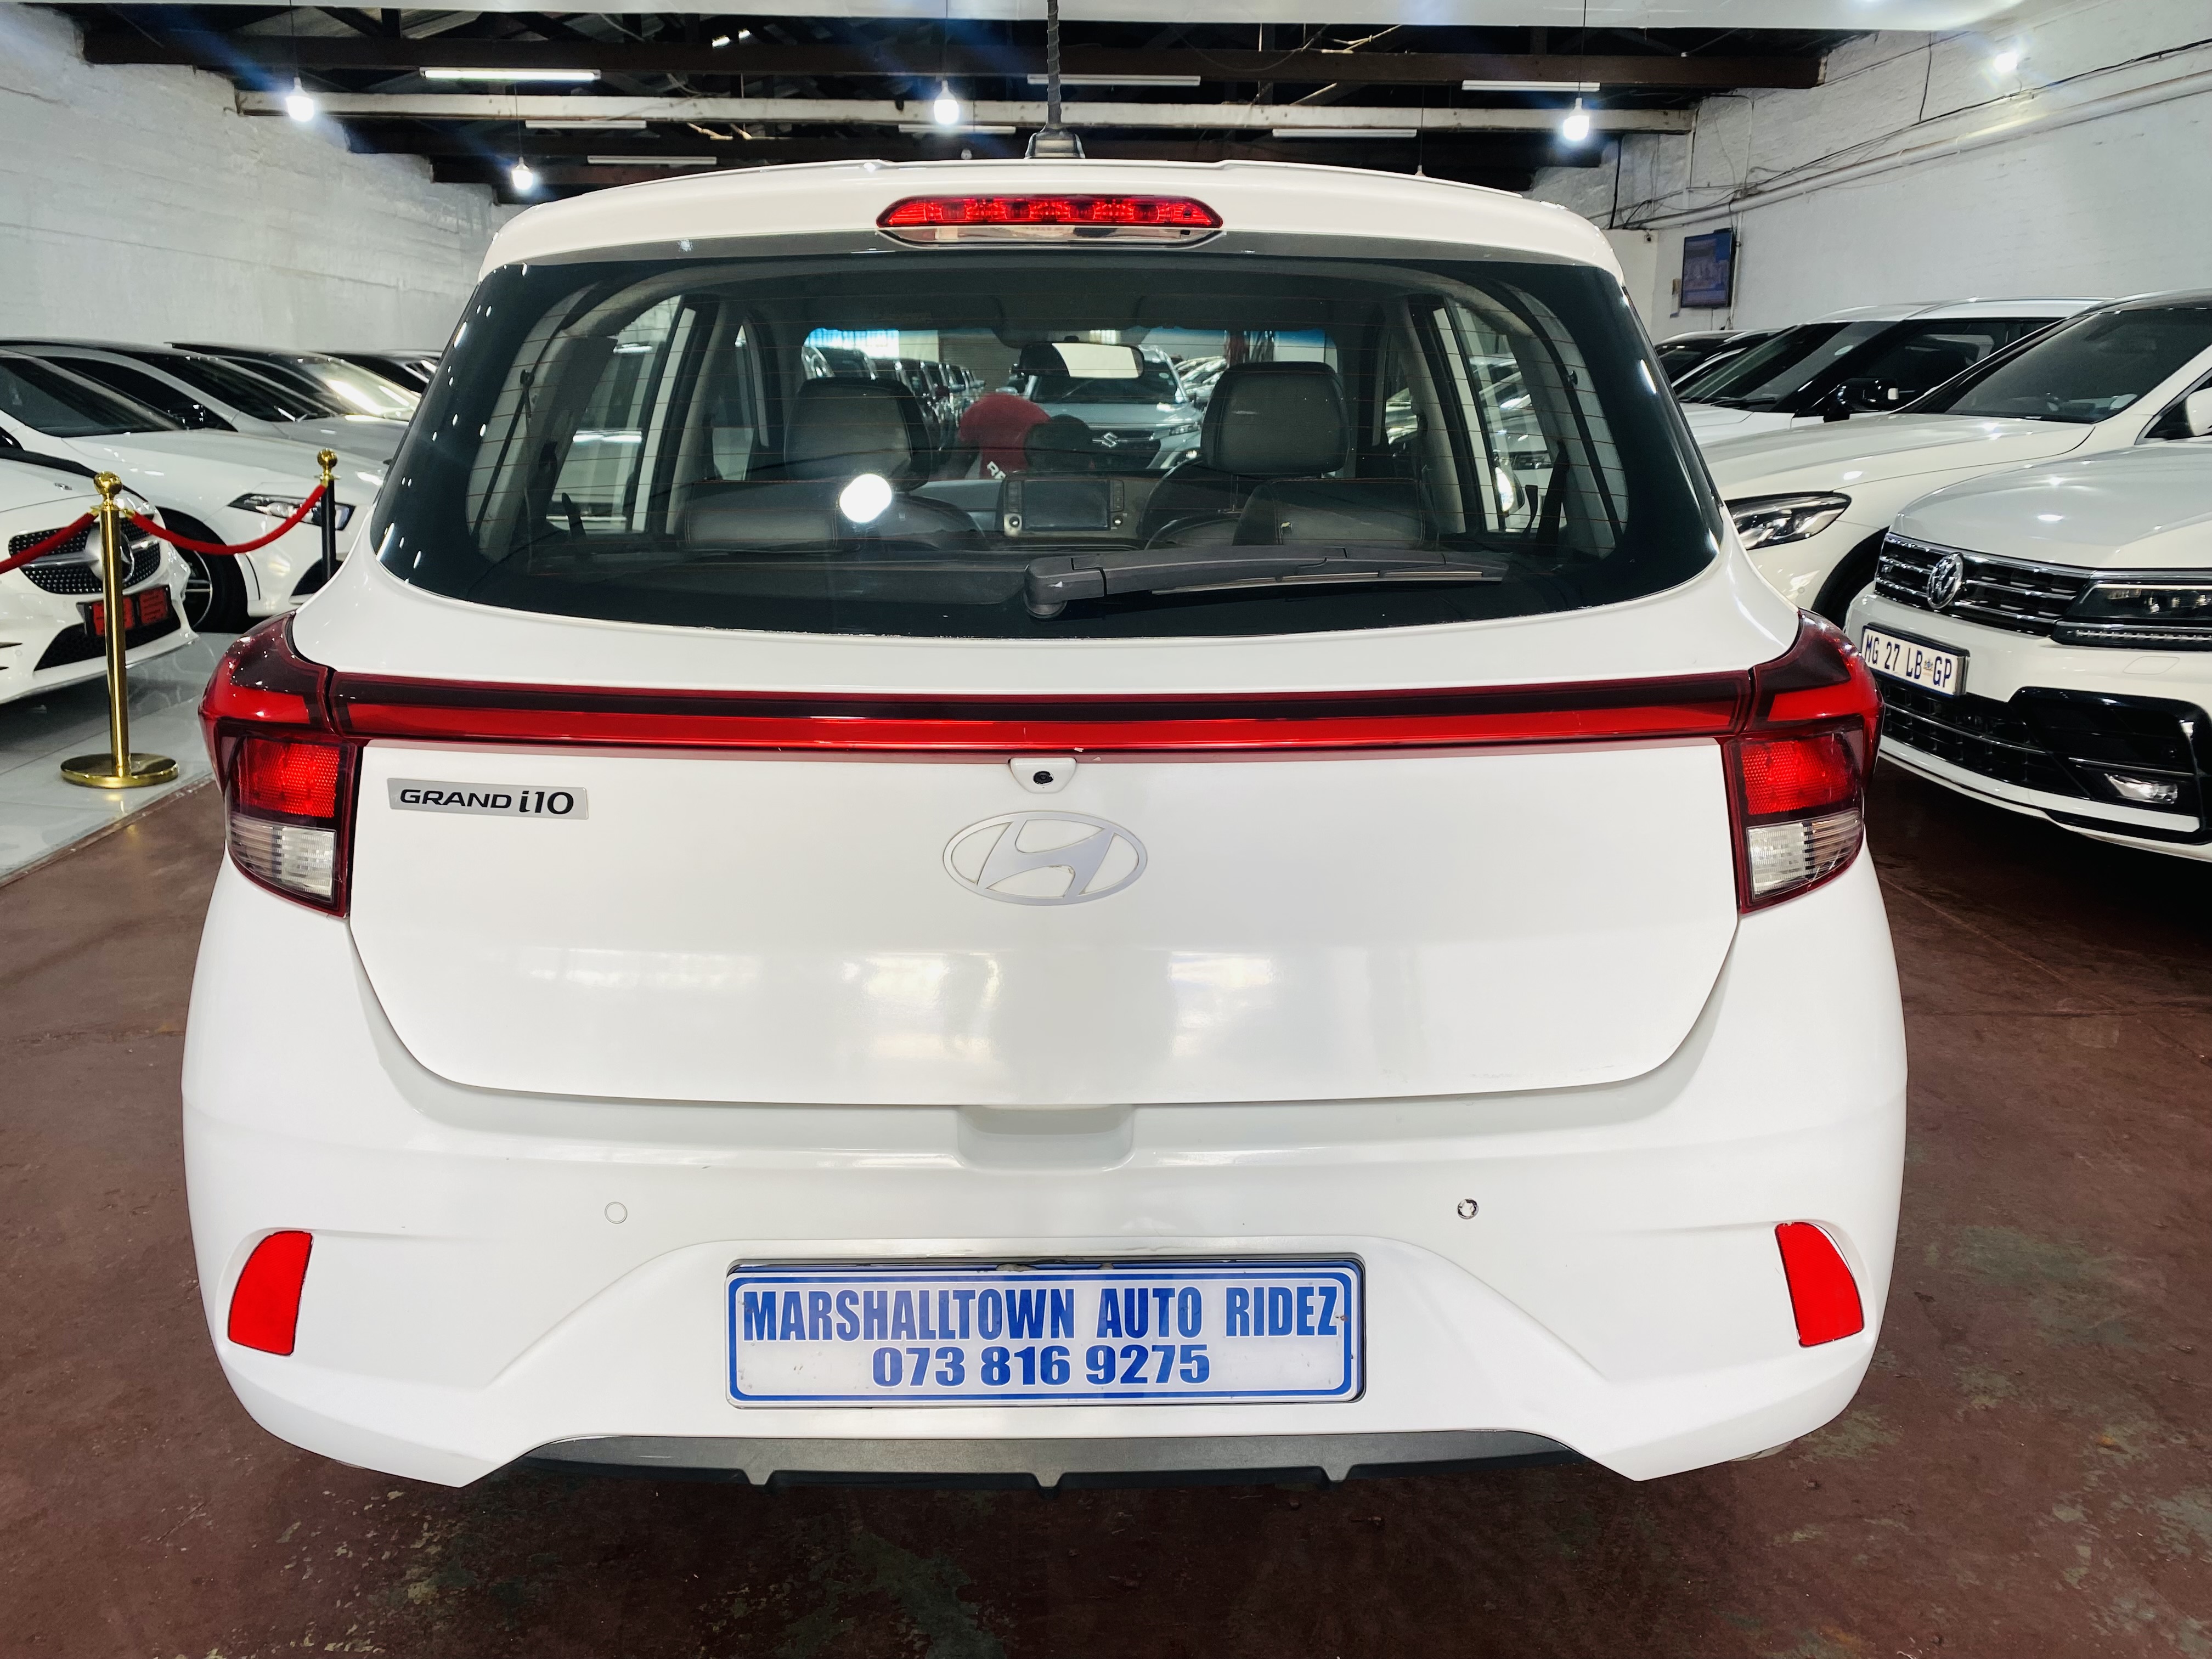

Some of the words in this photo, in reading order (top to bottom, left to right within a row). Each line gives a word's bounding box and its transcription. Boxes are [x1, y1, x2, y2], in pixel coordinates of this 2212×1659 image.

[1865, 634, 1880, 664] MG
[1884, 641, 1900, 672] 27
[1906, 647, 1923, 680] LB
[1933, 656, 1952, 688] GP
[400, 788, 512, 809] GRAND
[518, 790, 574, 815] i10
[743, 1288, 1075, 1342] MARSHALLTOWN
[1097, 1286, 1201, 1339] AUTO
[1226, 1286, 1338, 1337] RIDEZ
[872, 1346, 966, 1388] 073
[981, 1345, 1070, 1386] 816
[1085, 1344, 1210, 1385] 9275
